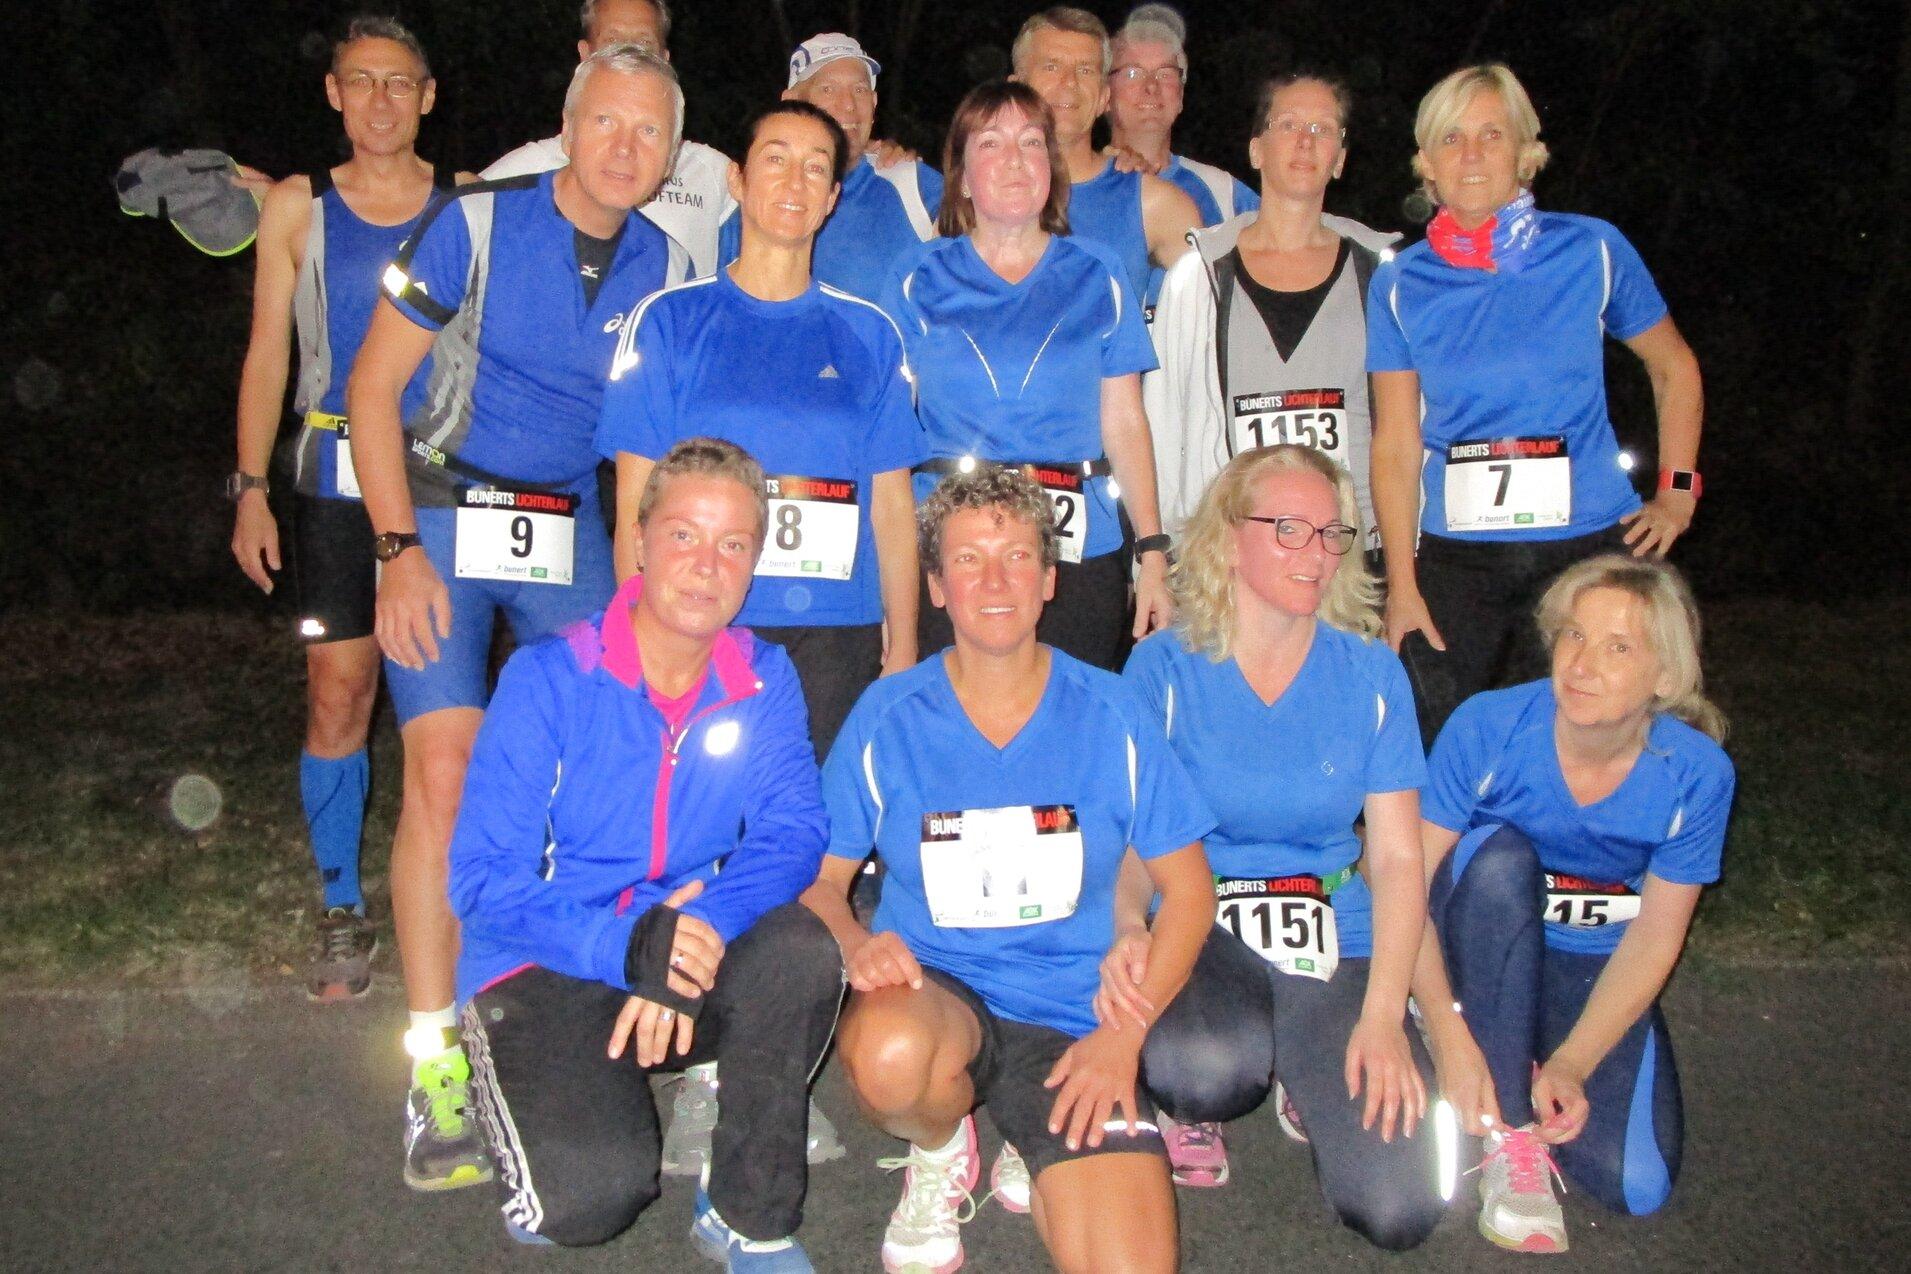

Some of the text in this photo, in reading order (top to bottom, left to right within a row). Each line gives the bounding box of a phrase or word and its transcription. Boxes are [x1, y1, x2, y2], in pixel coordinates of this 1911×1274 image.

[1240, 396, 1283, 411] BUNERTS
[1248, 412, 1339, 450] 1153
[1451, 443, 1490, 459] BUNERTS
[466, 490, 515, 506] BUNERTS
[1488, 464, 1512, 507] 7
[510, 515, 533, 558] 9
[776, 504, 802, 551] 8
[1222, 902, 1325, 954] 1151
[1553, 899, 1609, 927] 15
